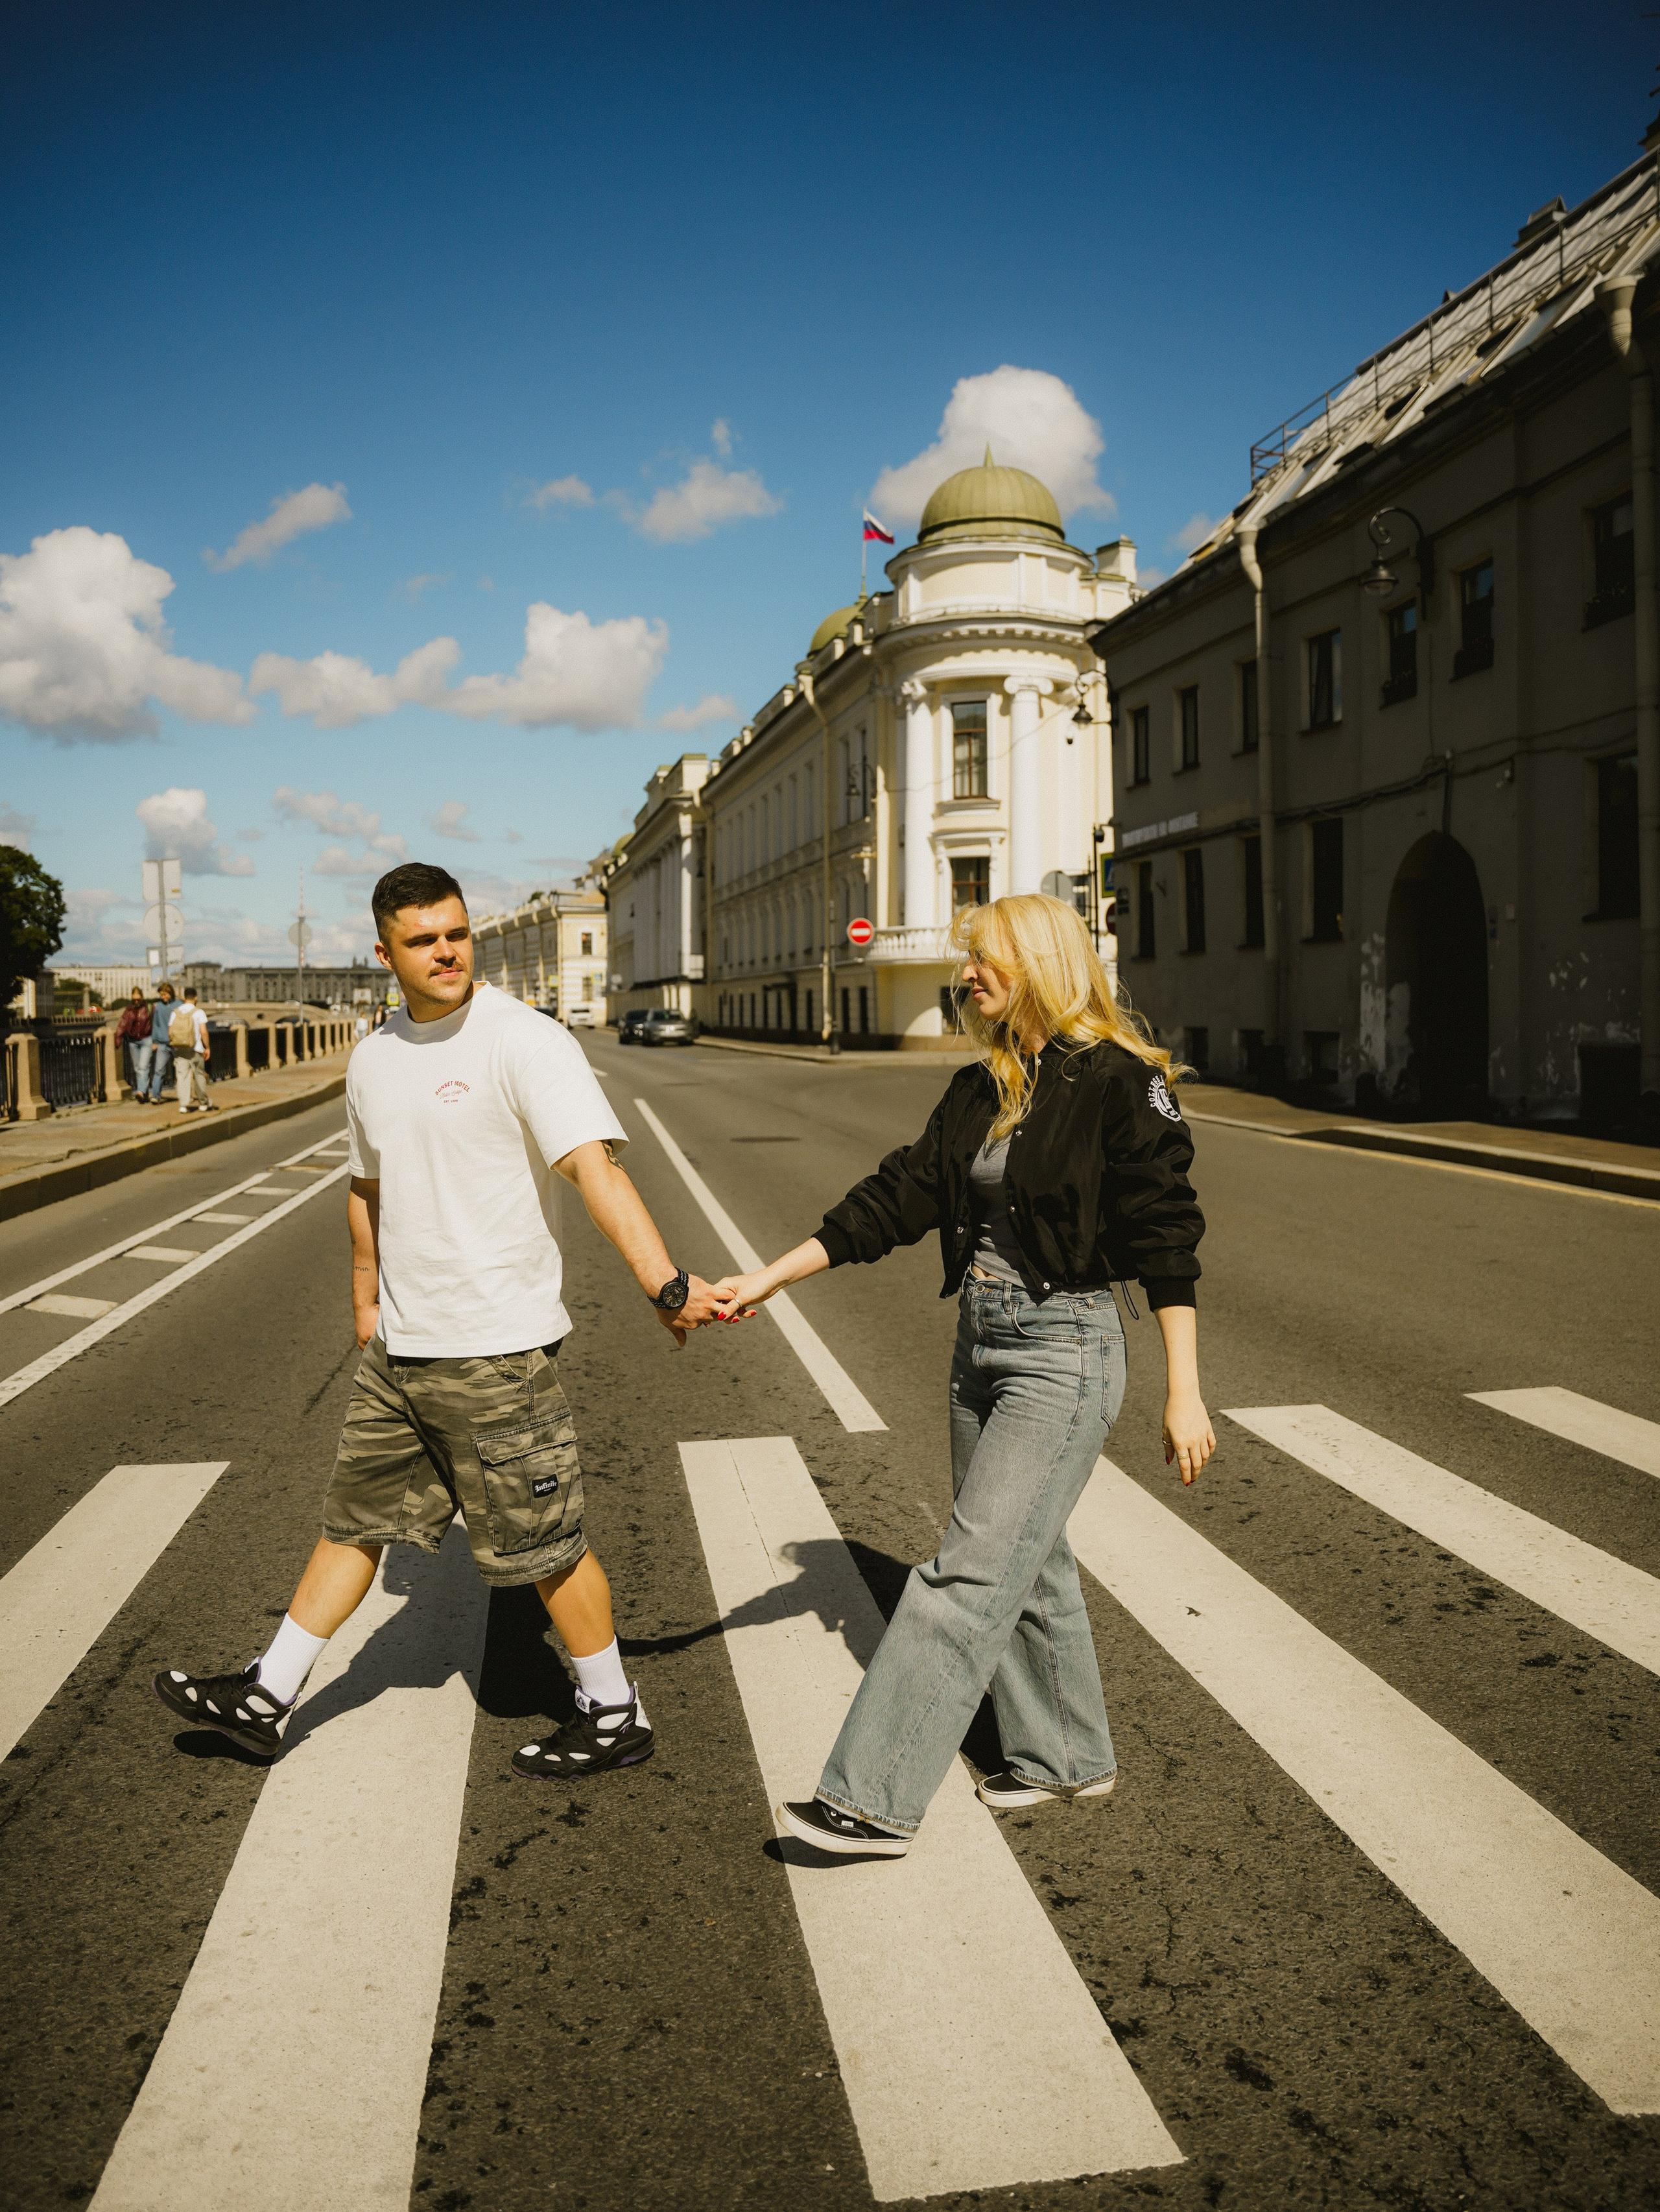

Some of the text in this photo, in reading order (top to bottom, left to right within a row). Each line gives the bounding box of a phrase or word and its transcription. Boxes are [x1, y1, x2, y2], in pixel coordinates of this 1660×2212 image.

[435, 1080, 453, 1095] SUNSET
[454, 1080, 471, 1093] MOTEL
[1148, 1075, 1161, 1107] COLLEGE
